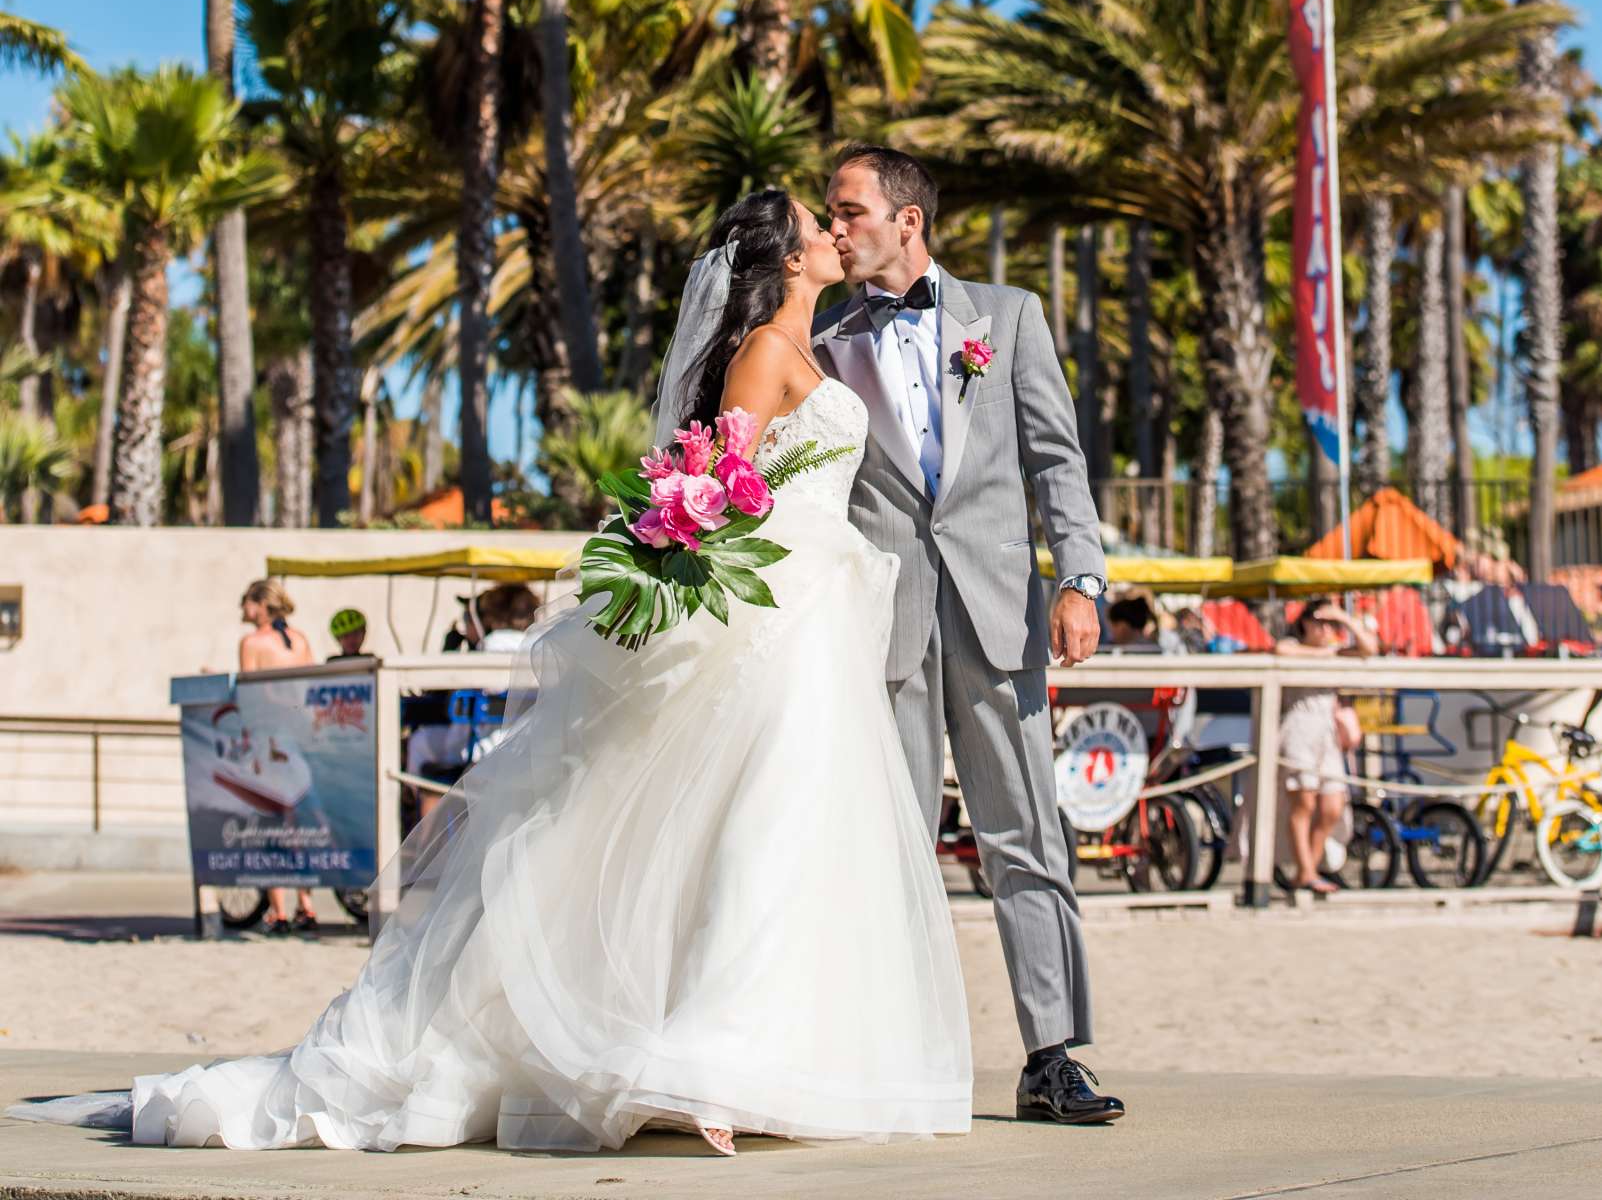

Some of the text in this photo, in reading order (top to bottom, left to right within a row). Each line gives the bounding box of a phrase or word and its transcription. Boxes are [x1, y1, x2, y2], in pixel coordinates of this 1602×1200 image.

[305, 685, 371, 706] ACTION
[209, 851, 351, 870] BOAT RENTALS HERE
